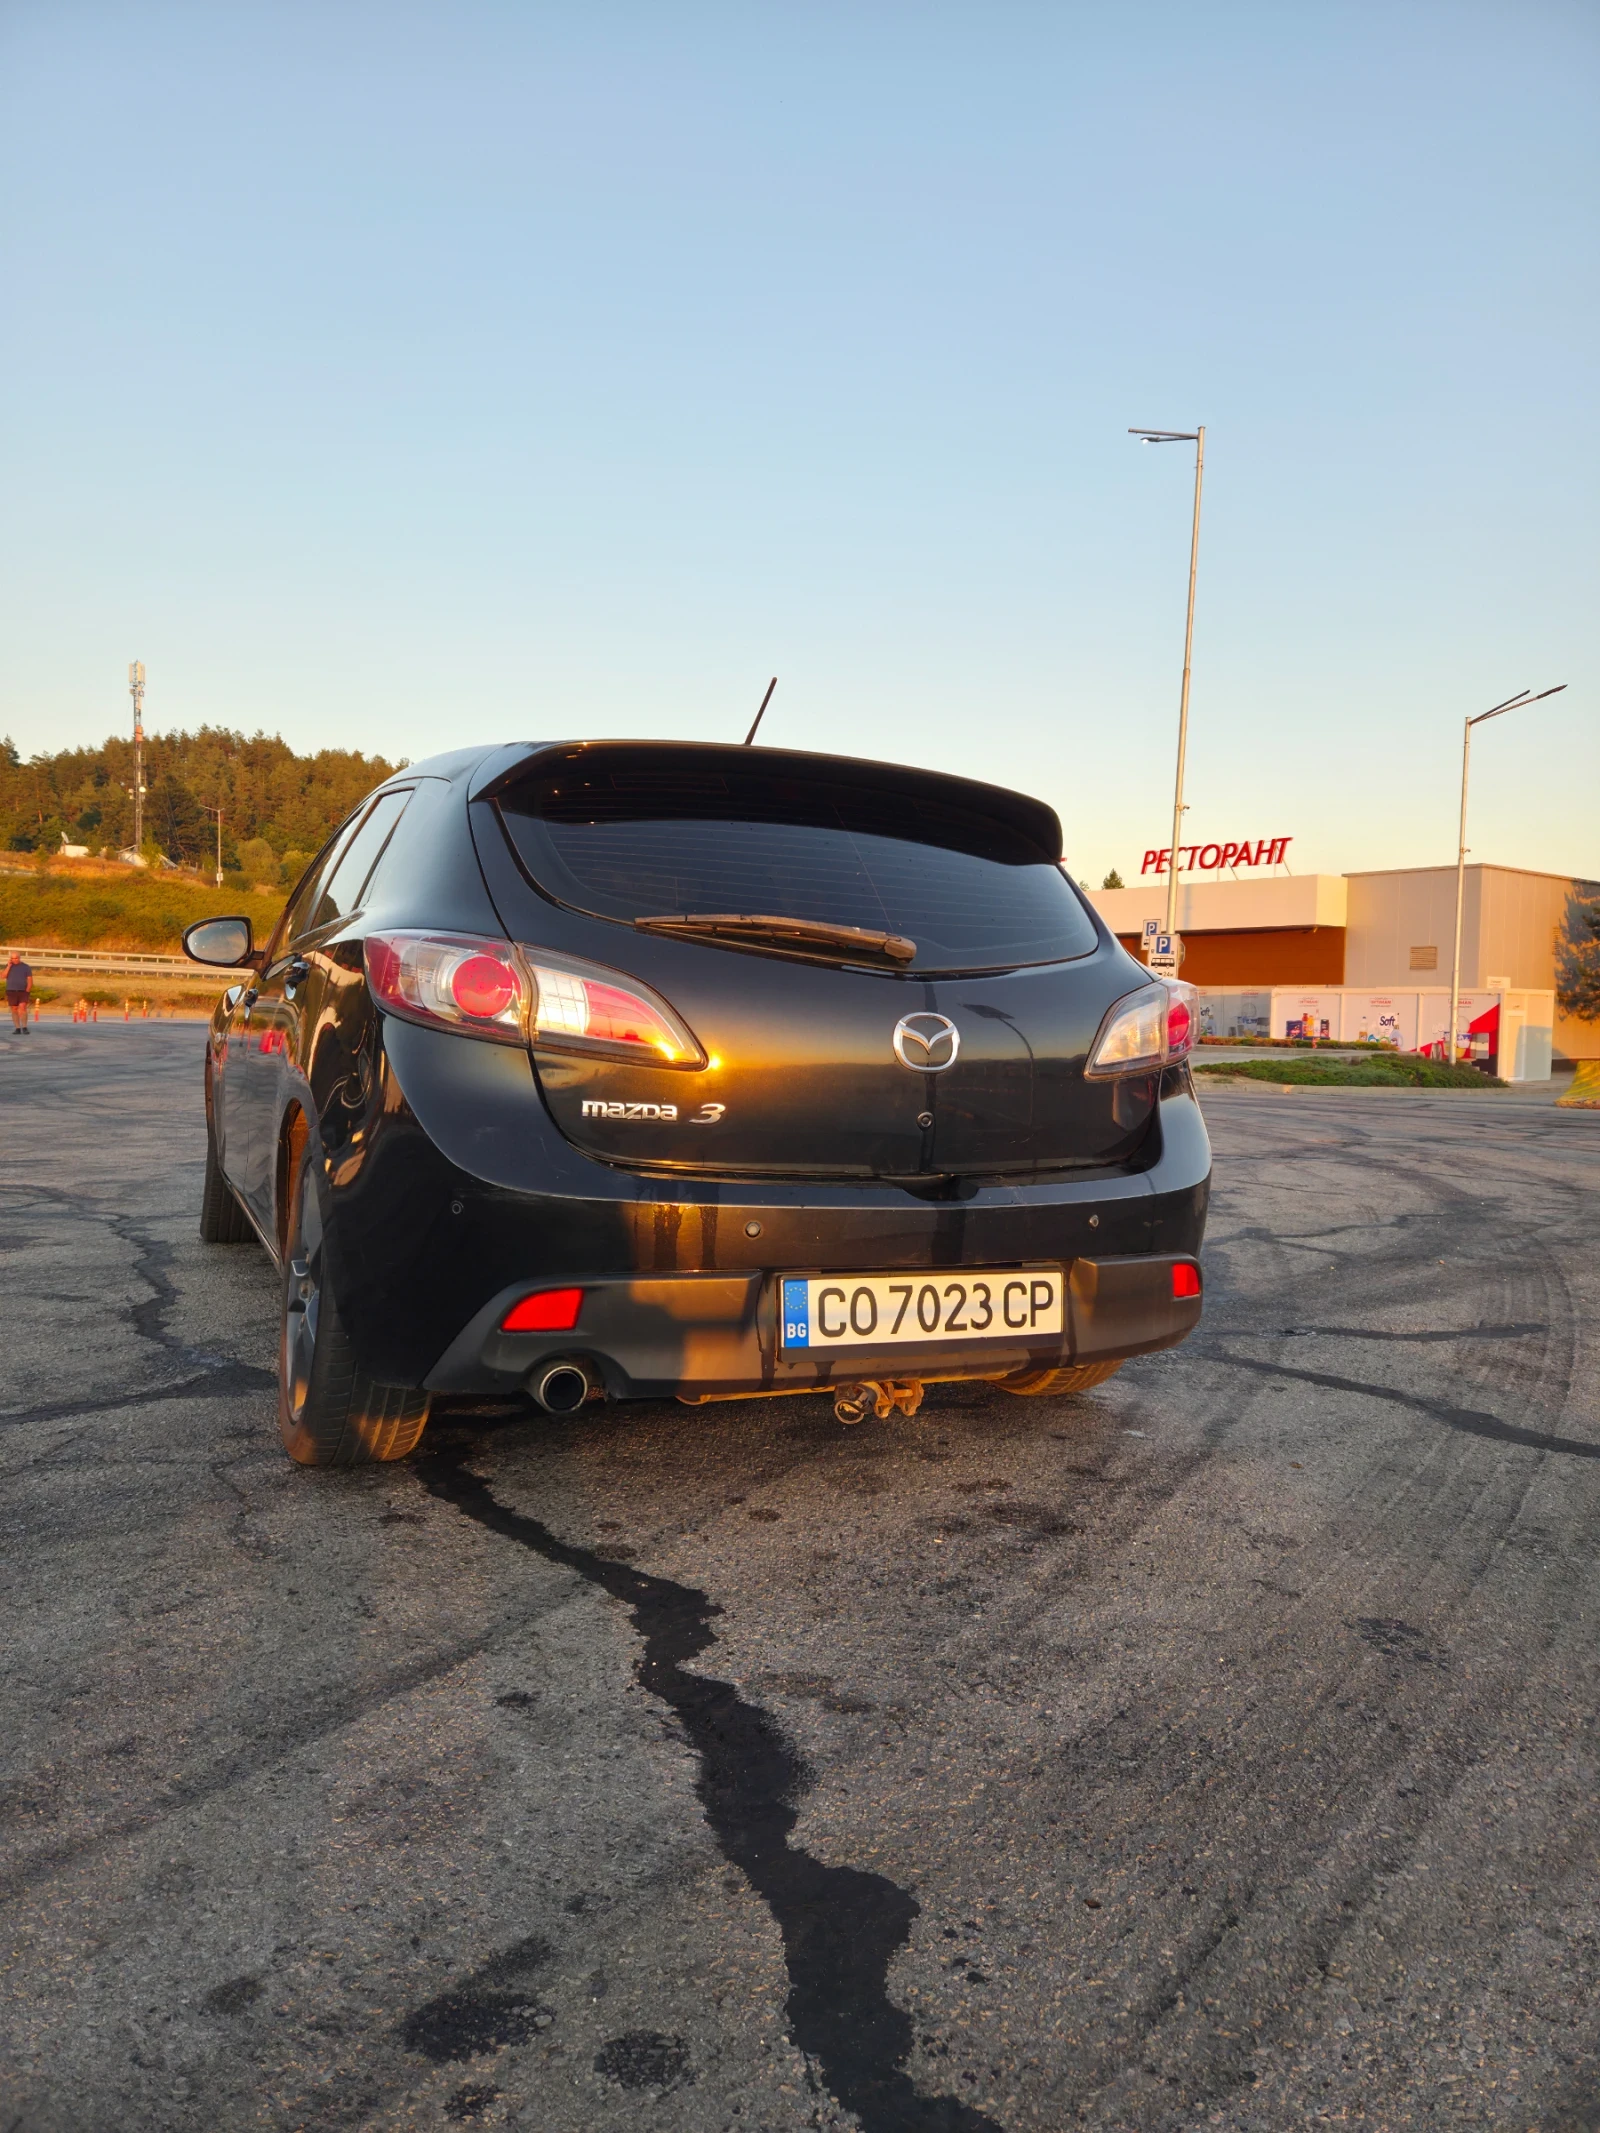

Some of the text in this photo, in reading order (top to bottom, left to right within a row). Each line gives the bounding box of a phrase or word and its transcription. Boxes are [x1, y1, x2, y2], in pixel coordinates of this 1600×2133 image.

[1141, 837, 1293, 875] РЕСТОРАНТ
[1158, 937, 1168, 953] P
[1379, 1015, 1396, 1026] Soft
[688, 1103, 726, 1124] 3
[818, 1280, 1054, 1338] CO 7023 CP
[787, 1323, 807, 1339] BG
